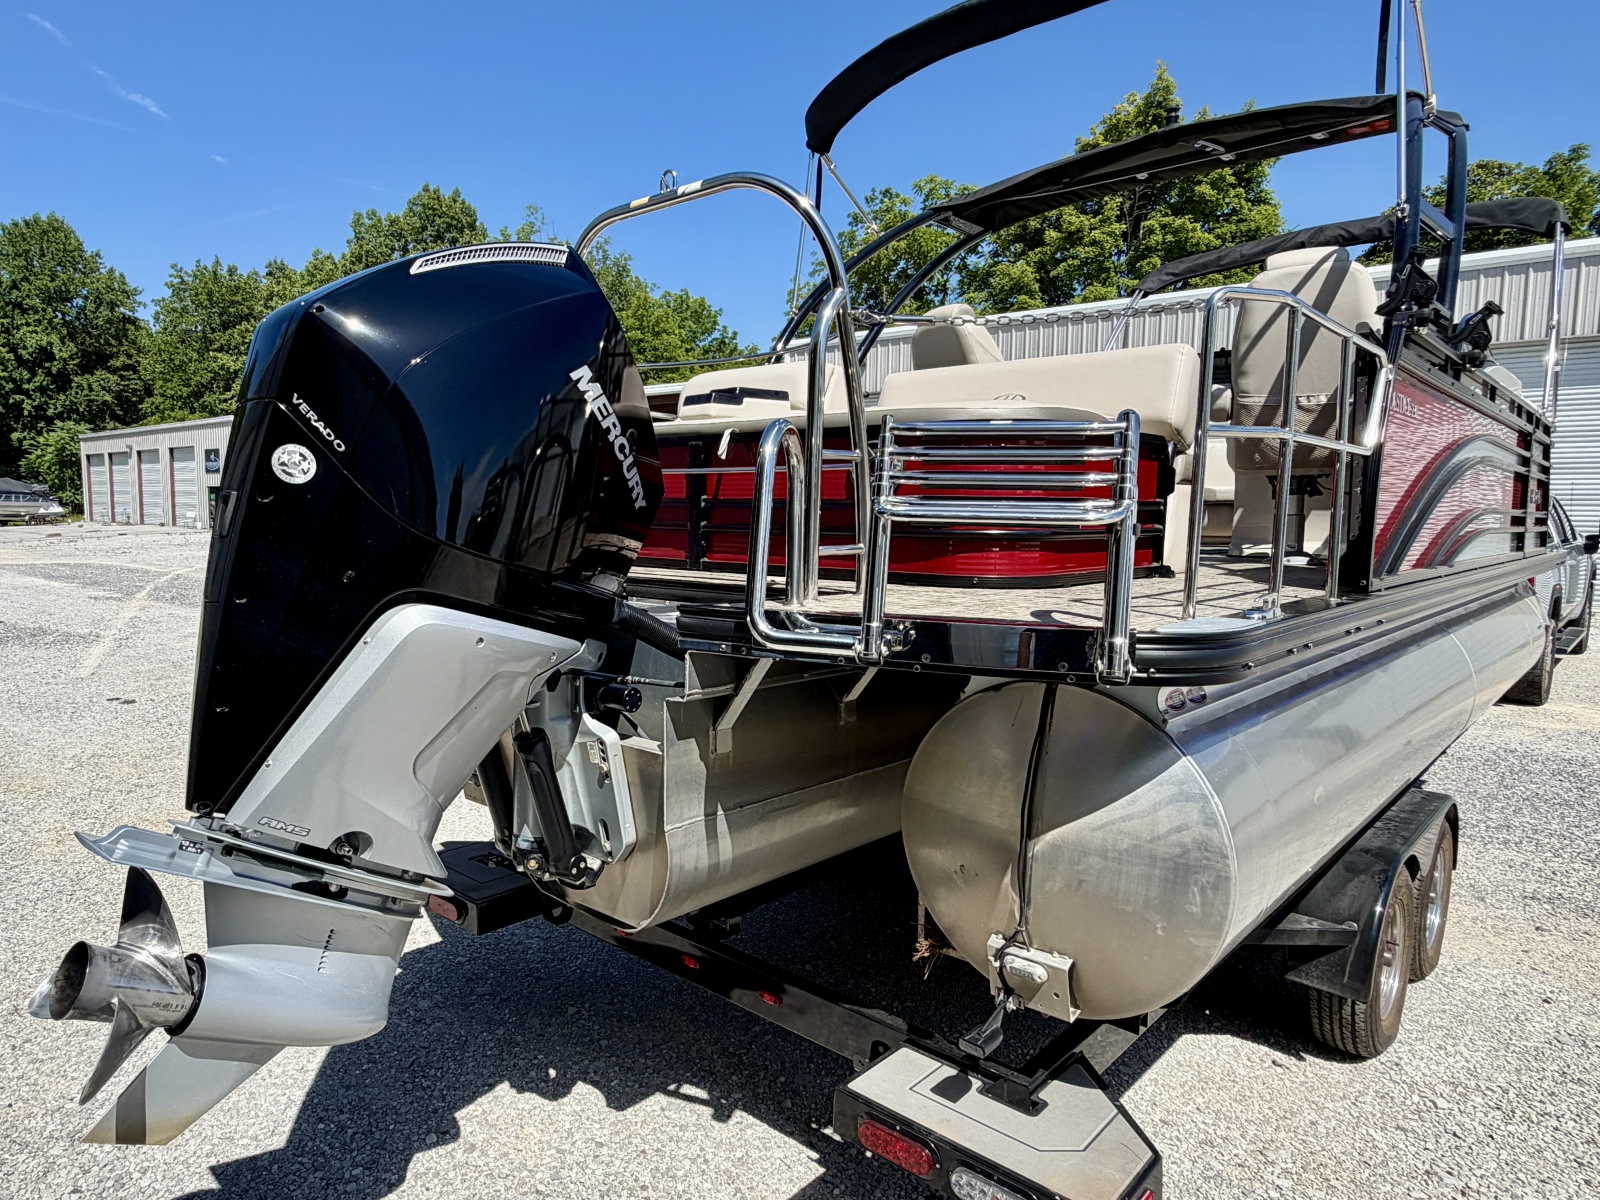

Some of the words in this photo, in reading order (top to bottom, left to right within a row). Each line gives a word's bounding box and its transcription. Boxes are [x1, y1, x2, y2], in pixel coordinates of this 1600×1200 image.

[292, 392, 346, 452] VERADO
[569, 364, 646, 511] MERCURY
[257, 816, 312, 837] AMS
